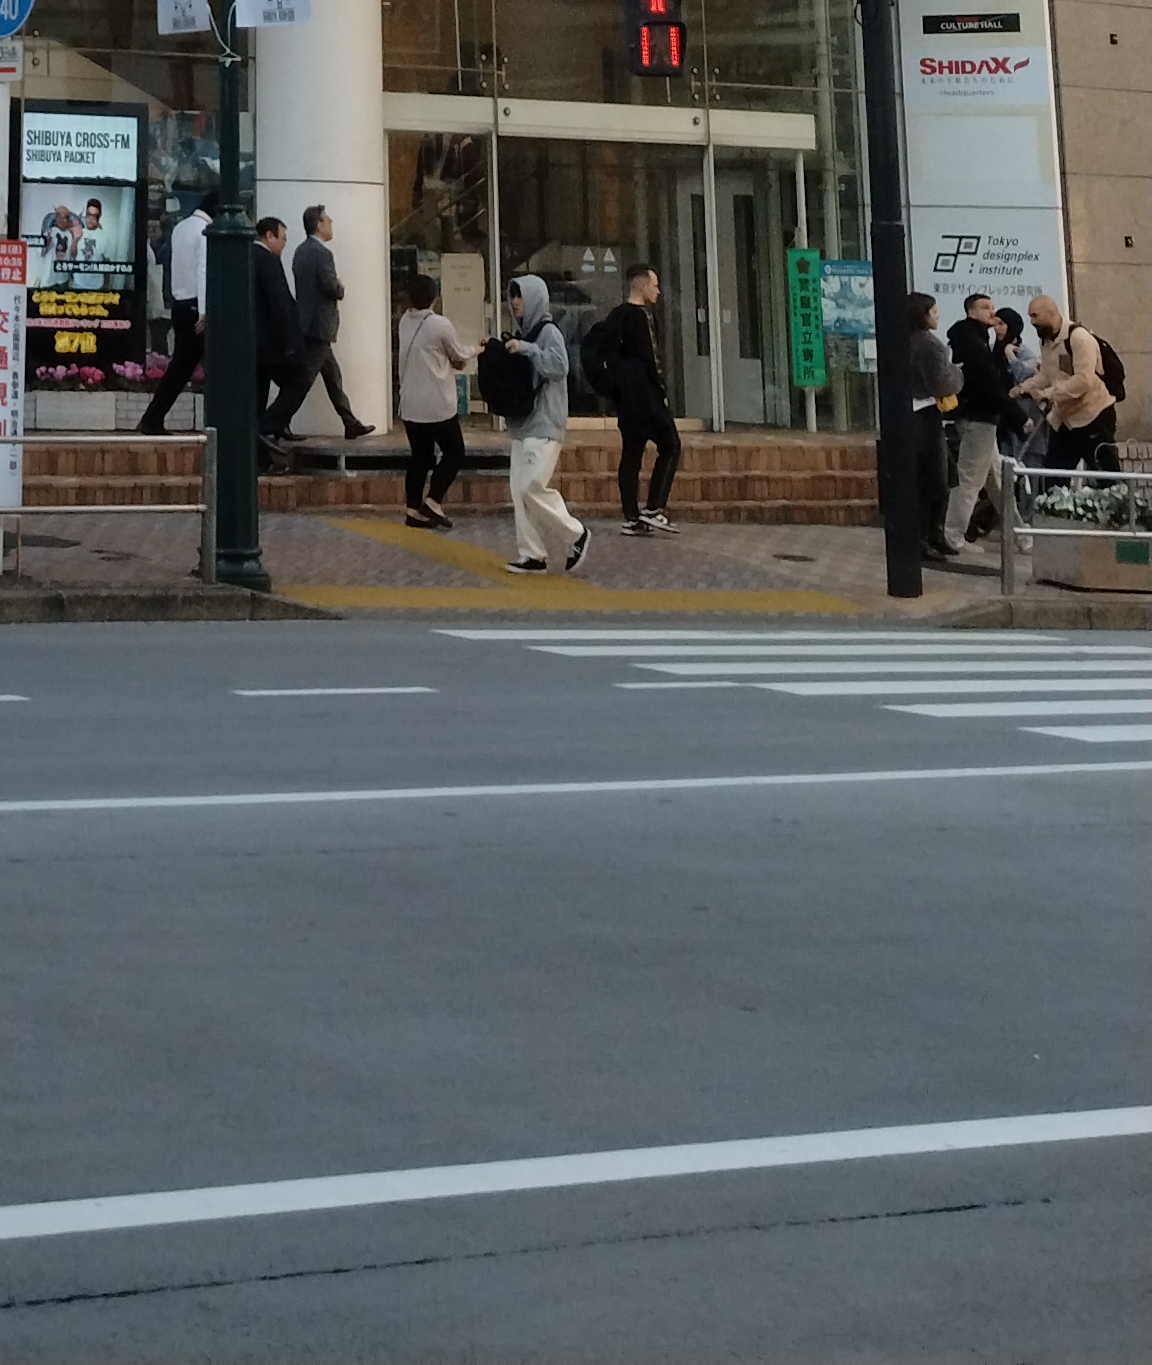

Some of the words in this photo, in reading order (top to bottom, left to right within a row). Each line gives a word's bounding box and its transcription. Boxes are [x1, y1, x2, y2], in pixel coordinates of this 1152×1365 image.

[940, 22, 979, 31] CULTURE
[979, 21, 1003, 30] HALL
[919, 56, 1012, 76] SHIDAX
[26, 129, 73, 147] SHIBUYA
[74, 131, 131, 150] CROSS-FM
[25, 148, 63, 164] SHIBUYA
[64, 150, 96, 165] PACKET
[987, 235, 1019, 249] Tokyo
[982, 249, 1040, 263] designplex
[978, 262, 1024, 276] institute
[933, 282, 1043, 297] 東京デザインプレックス研究所
